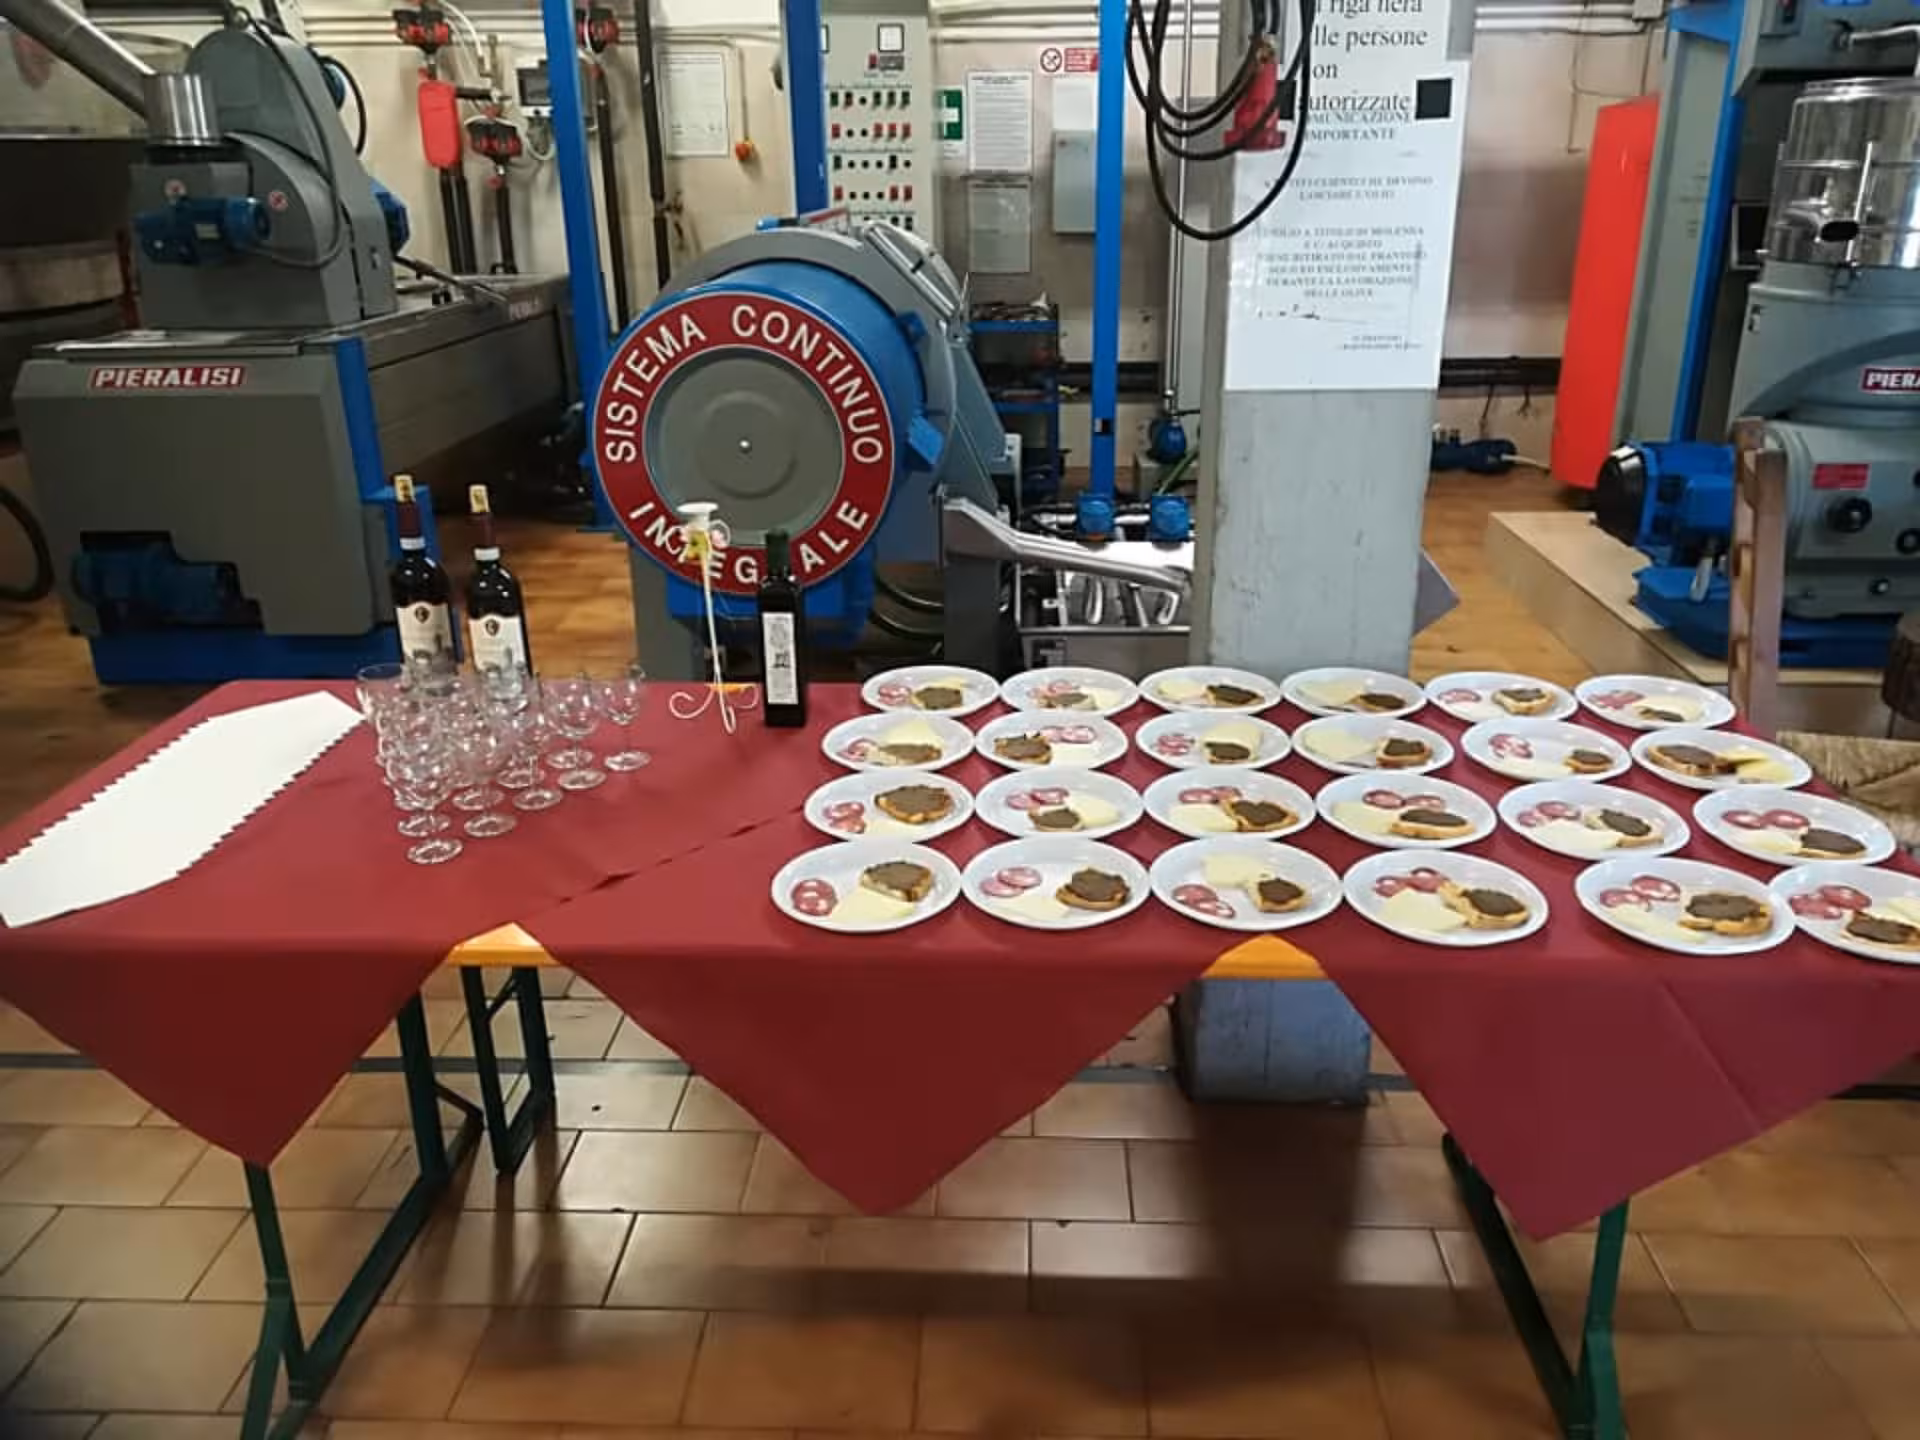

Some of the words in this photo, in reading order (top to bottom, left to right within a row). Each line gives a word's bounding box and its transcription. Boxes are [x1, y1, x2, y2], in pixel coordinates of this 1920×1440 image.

[1314, 25, 1340, 45] lle
[1345, 30, 1428, 52] persone
[1312, 63, 1338, 79] on
[95, 367, 242, 388] PIERALISI
[605, 313, 707, 463] SISTEMA
[732, 305, 884, 464] CONTINUO
[629, 501, 869, 584] INEGALE
